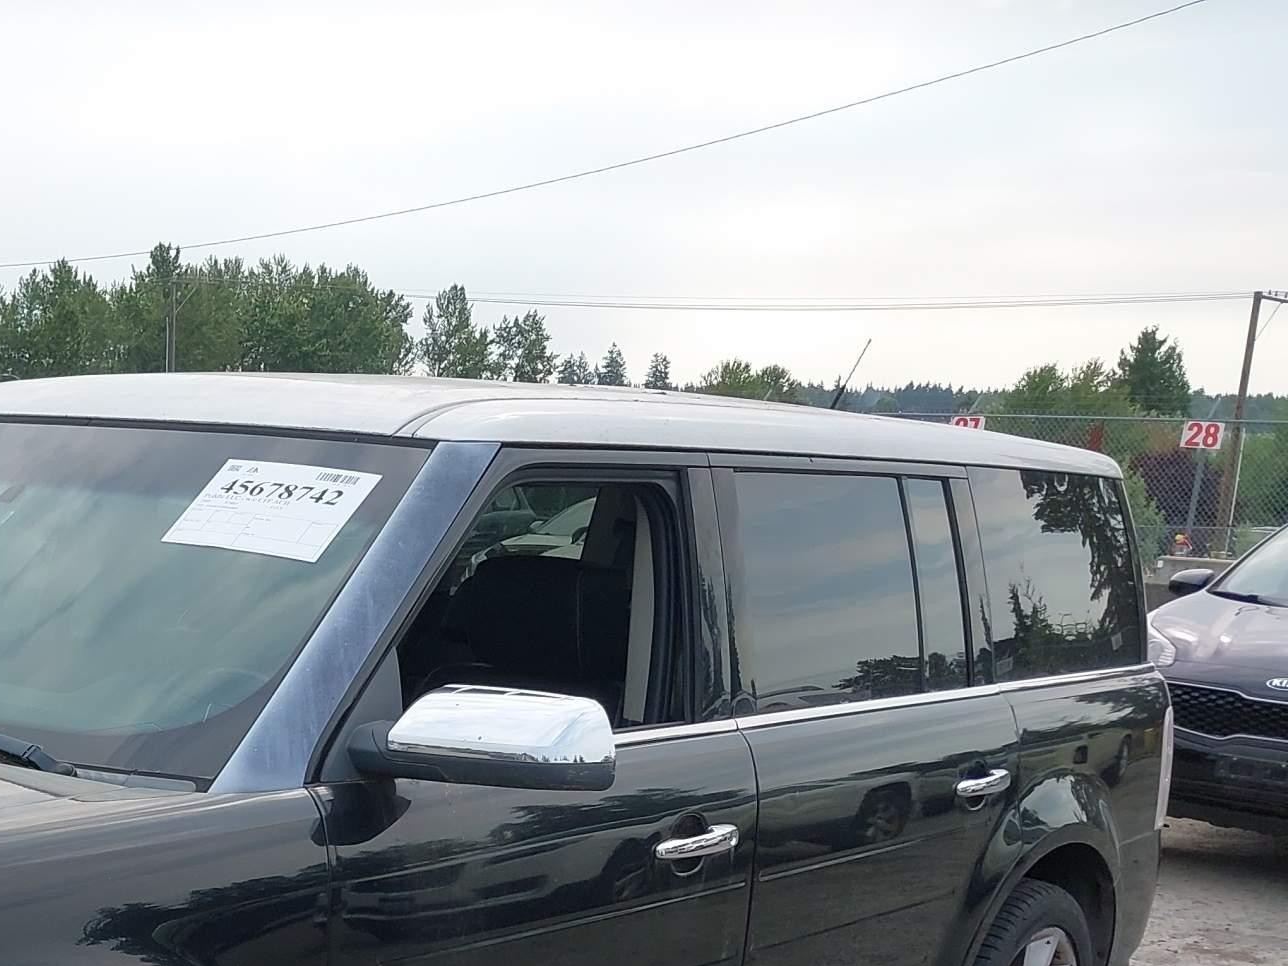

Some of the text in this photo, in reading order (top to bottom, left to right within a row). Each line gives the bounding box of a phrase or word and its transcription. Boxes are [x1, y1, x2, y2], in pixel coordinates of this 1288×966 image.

[1185, 422, 1220, 448] 28
[220, 479, 344, 506] 45678742
[1272, 679, 1288, 689] KI
